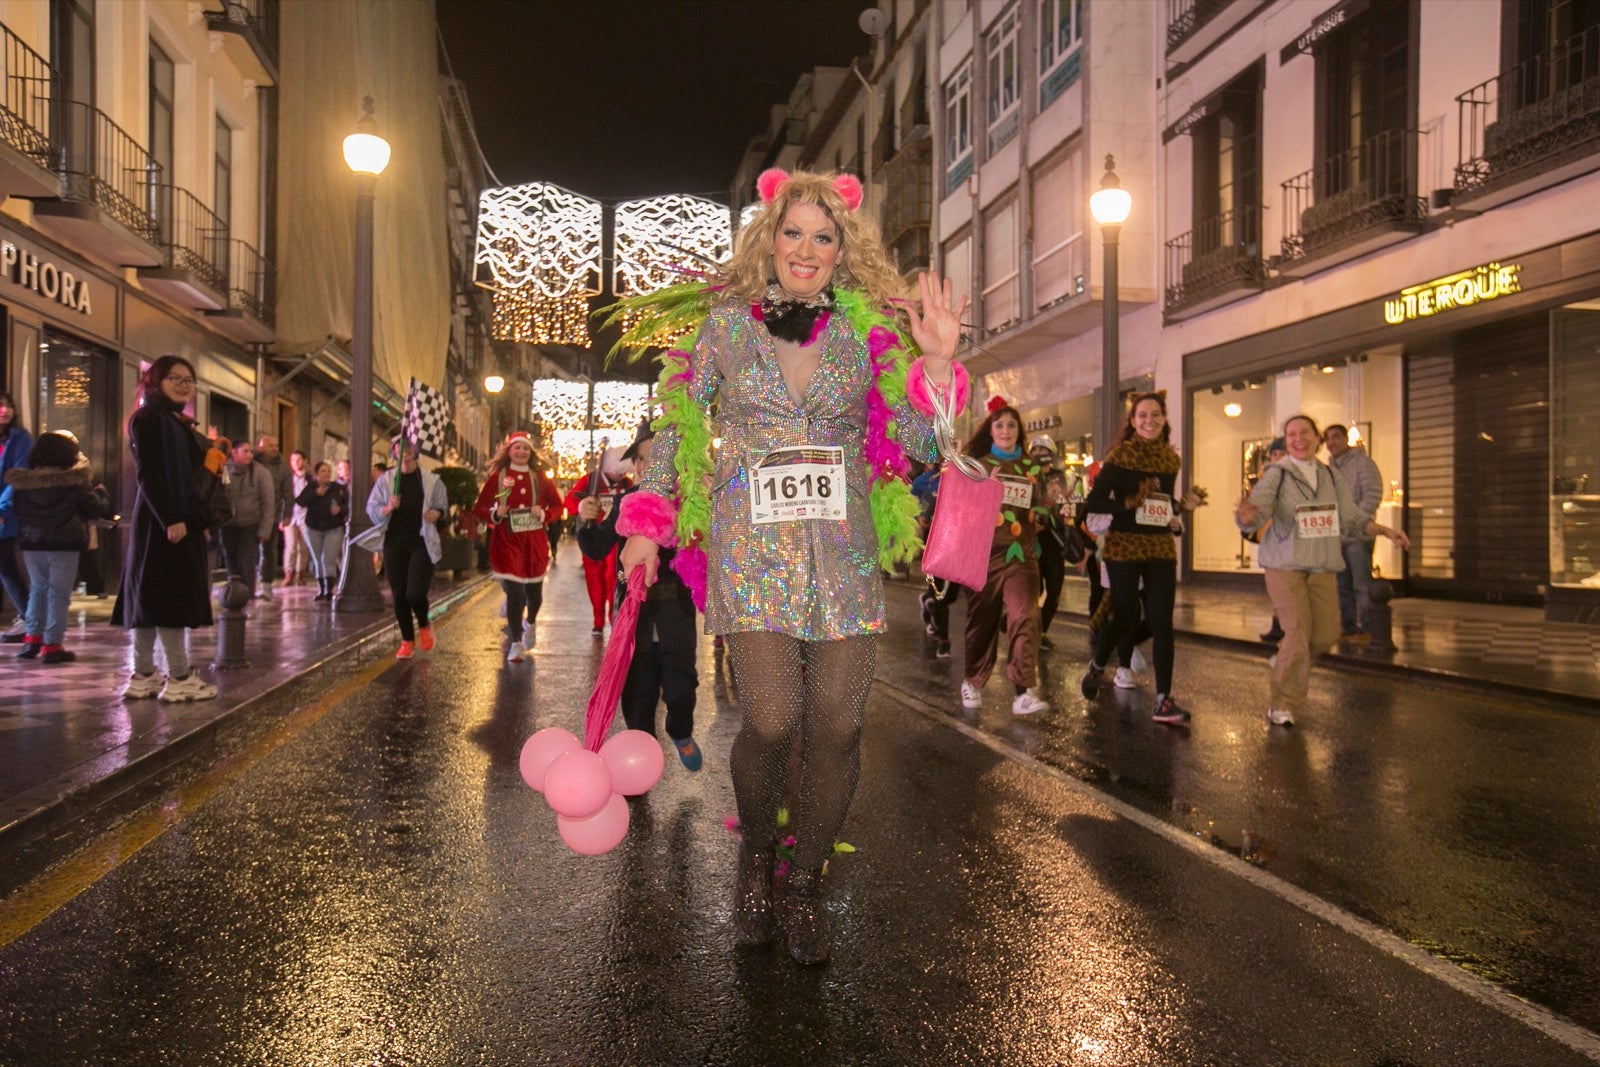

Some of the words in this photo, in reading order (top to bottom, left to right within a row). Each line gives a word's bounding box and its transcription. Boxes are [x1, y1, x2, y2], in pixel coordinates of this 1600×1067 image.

[0, 240, 92, 315] PHORA
[763, 474, 832, 501] 1618
[1142, 504, 1168, 516] 1804
[1302, 515, 1332, 528] 1836
